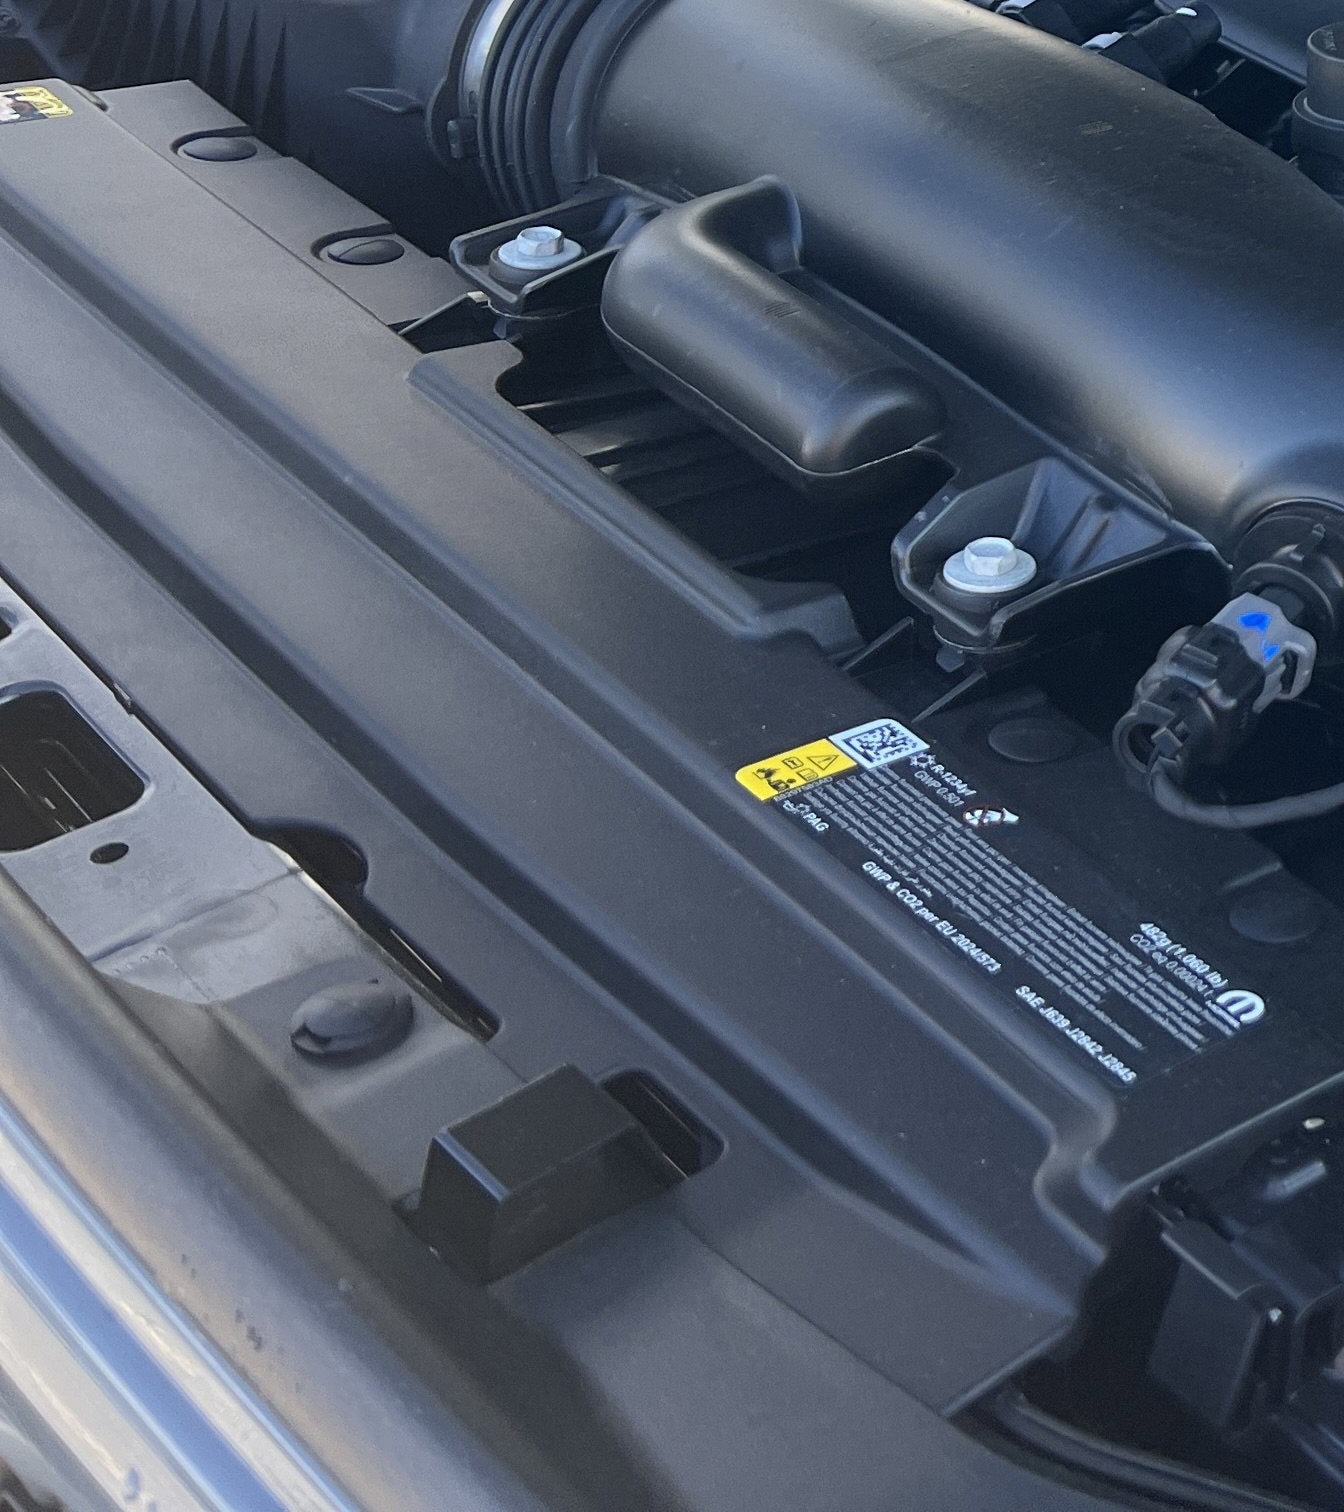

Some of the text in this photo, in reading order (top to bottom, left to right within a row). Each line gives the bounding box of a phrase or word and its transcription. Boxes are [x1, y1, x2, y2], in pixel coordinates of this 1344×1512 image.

[914, 770, 964, 808] GWP 0.501
[931, 763, 977, 796] R-1234yf
[803, 810, 830, 833] PAG
[862, 861, 1002, 974] GWP & CO2 per EU 2024/573
[1139, 923, 1172, 949] 482g
[1015, 985, 1138, 1084] SAE J639 J2842 J2845
